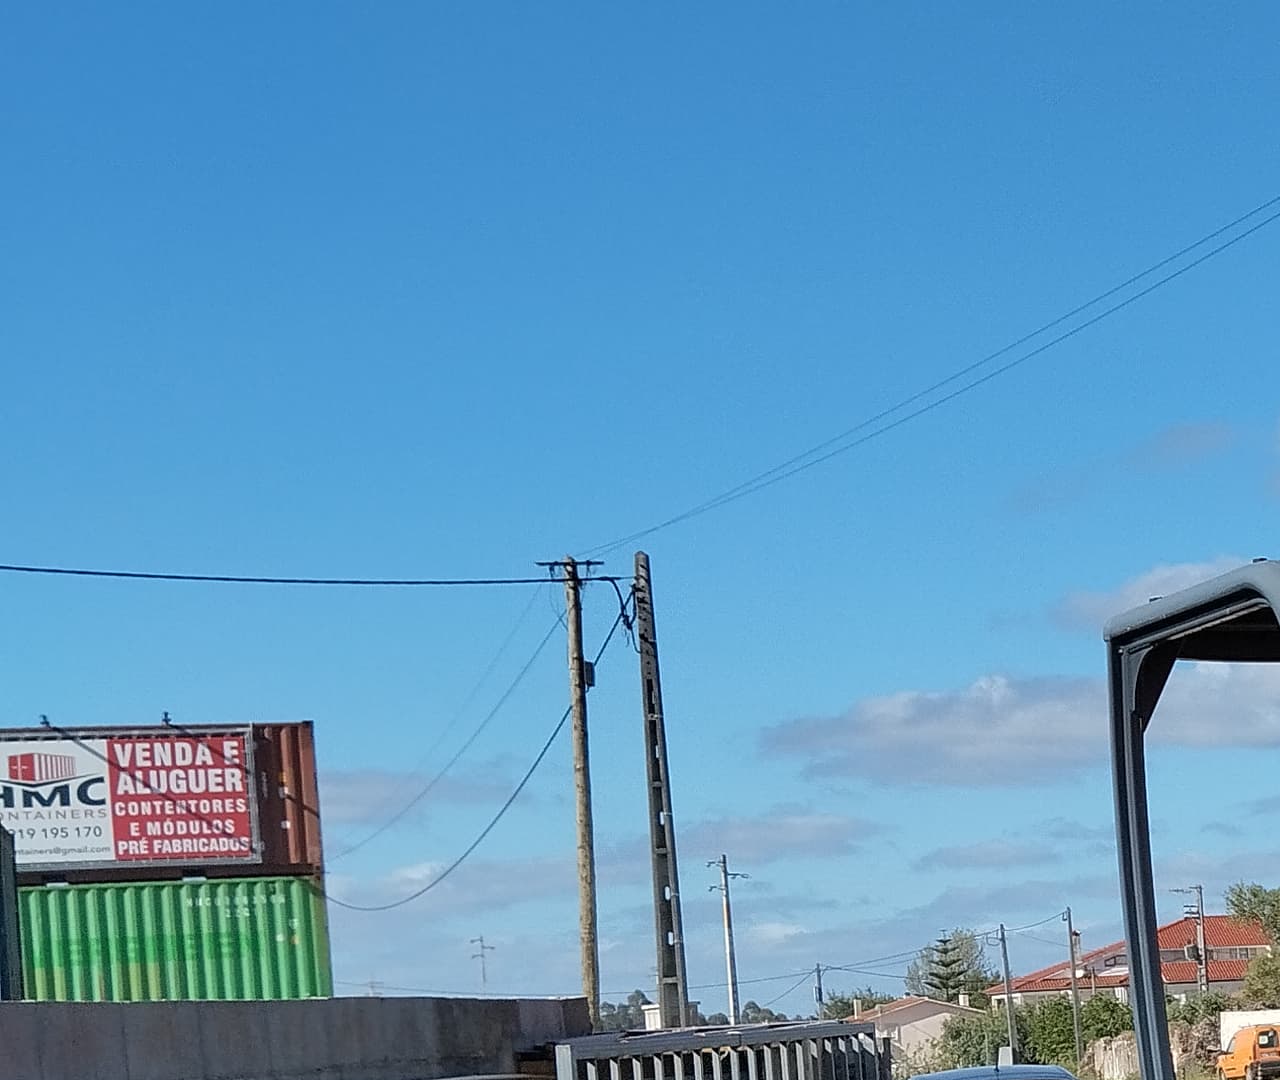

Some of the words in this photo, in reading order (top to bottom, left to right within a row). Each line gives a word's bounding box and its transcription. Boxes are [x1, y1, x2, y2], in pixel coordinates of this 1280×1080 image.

[114, 742, 213, 767] VENDA
[223, 741, 239, 765] E
[117, 768, 243, 795] ALUGUER
[115, 798, 246, 816] CONTENTORES
[42, 826, 69, 839] 195
[76, 825, 102, 838] 170
[130, 822, 140, 836] E
[147, 817, 235, 836] MÓDULOS
[118, 837, 149, 855] PRÉ
[153, 837, 250, 853] FABRICADOS
